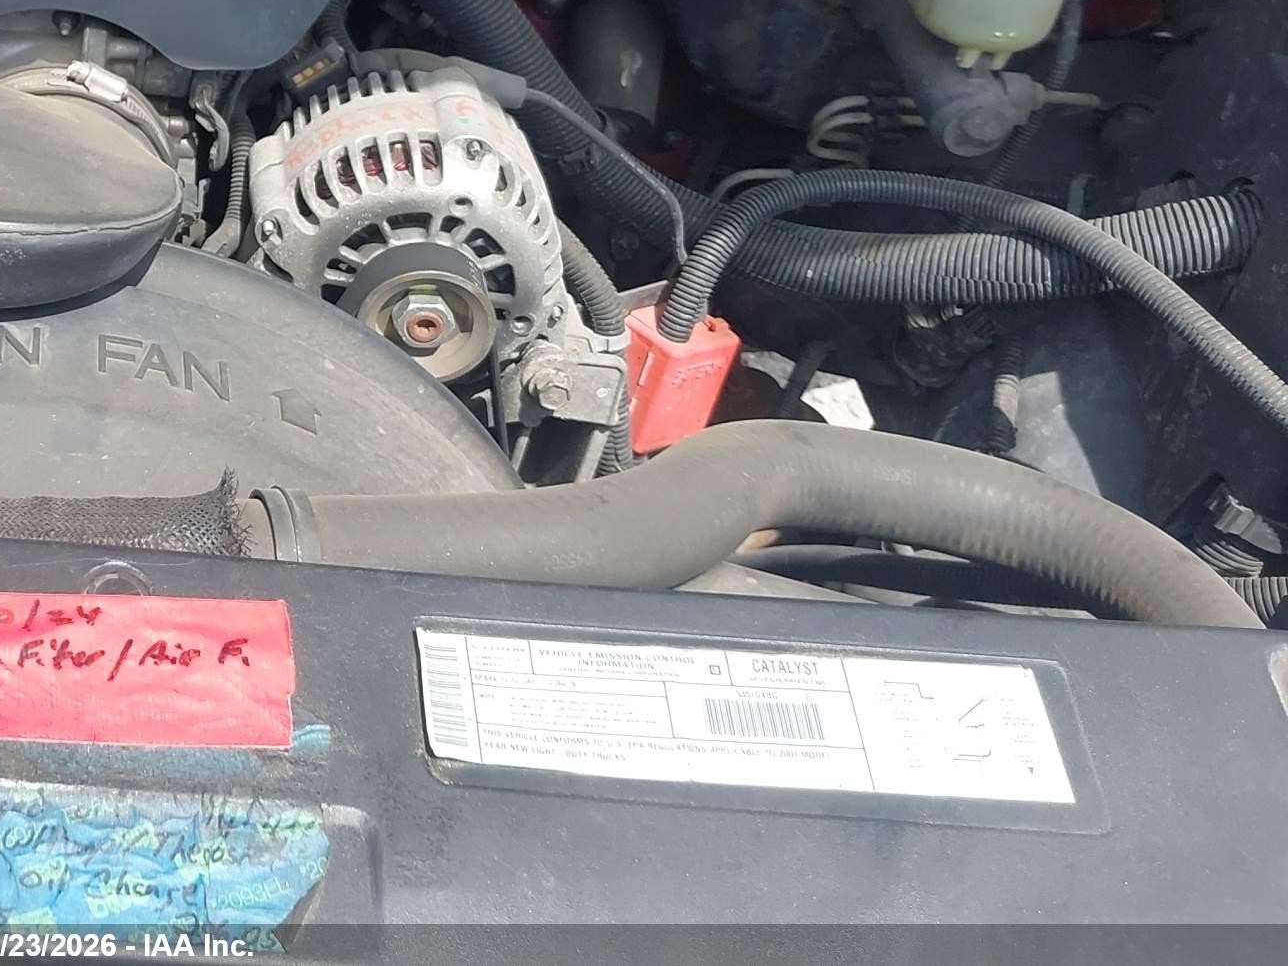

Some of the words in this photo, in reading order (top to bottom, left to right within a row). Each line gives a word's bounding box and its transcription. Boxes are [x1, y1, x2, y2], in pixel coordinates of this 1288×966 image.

[98, 333, 231, 402] FAN
[588, 651, 641, 662] EMISSION
[577, 659, 655, 671] INFORMATION
[751, 659, 820, 676] CATALYST
